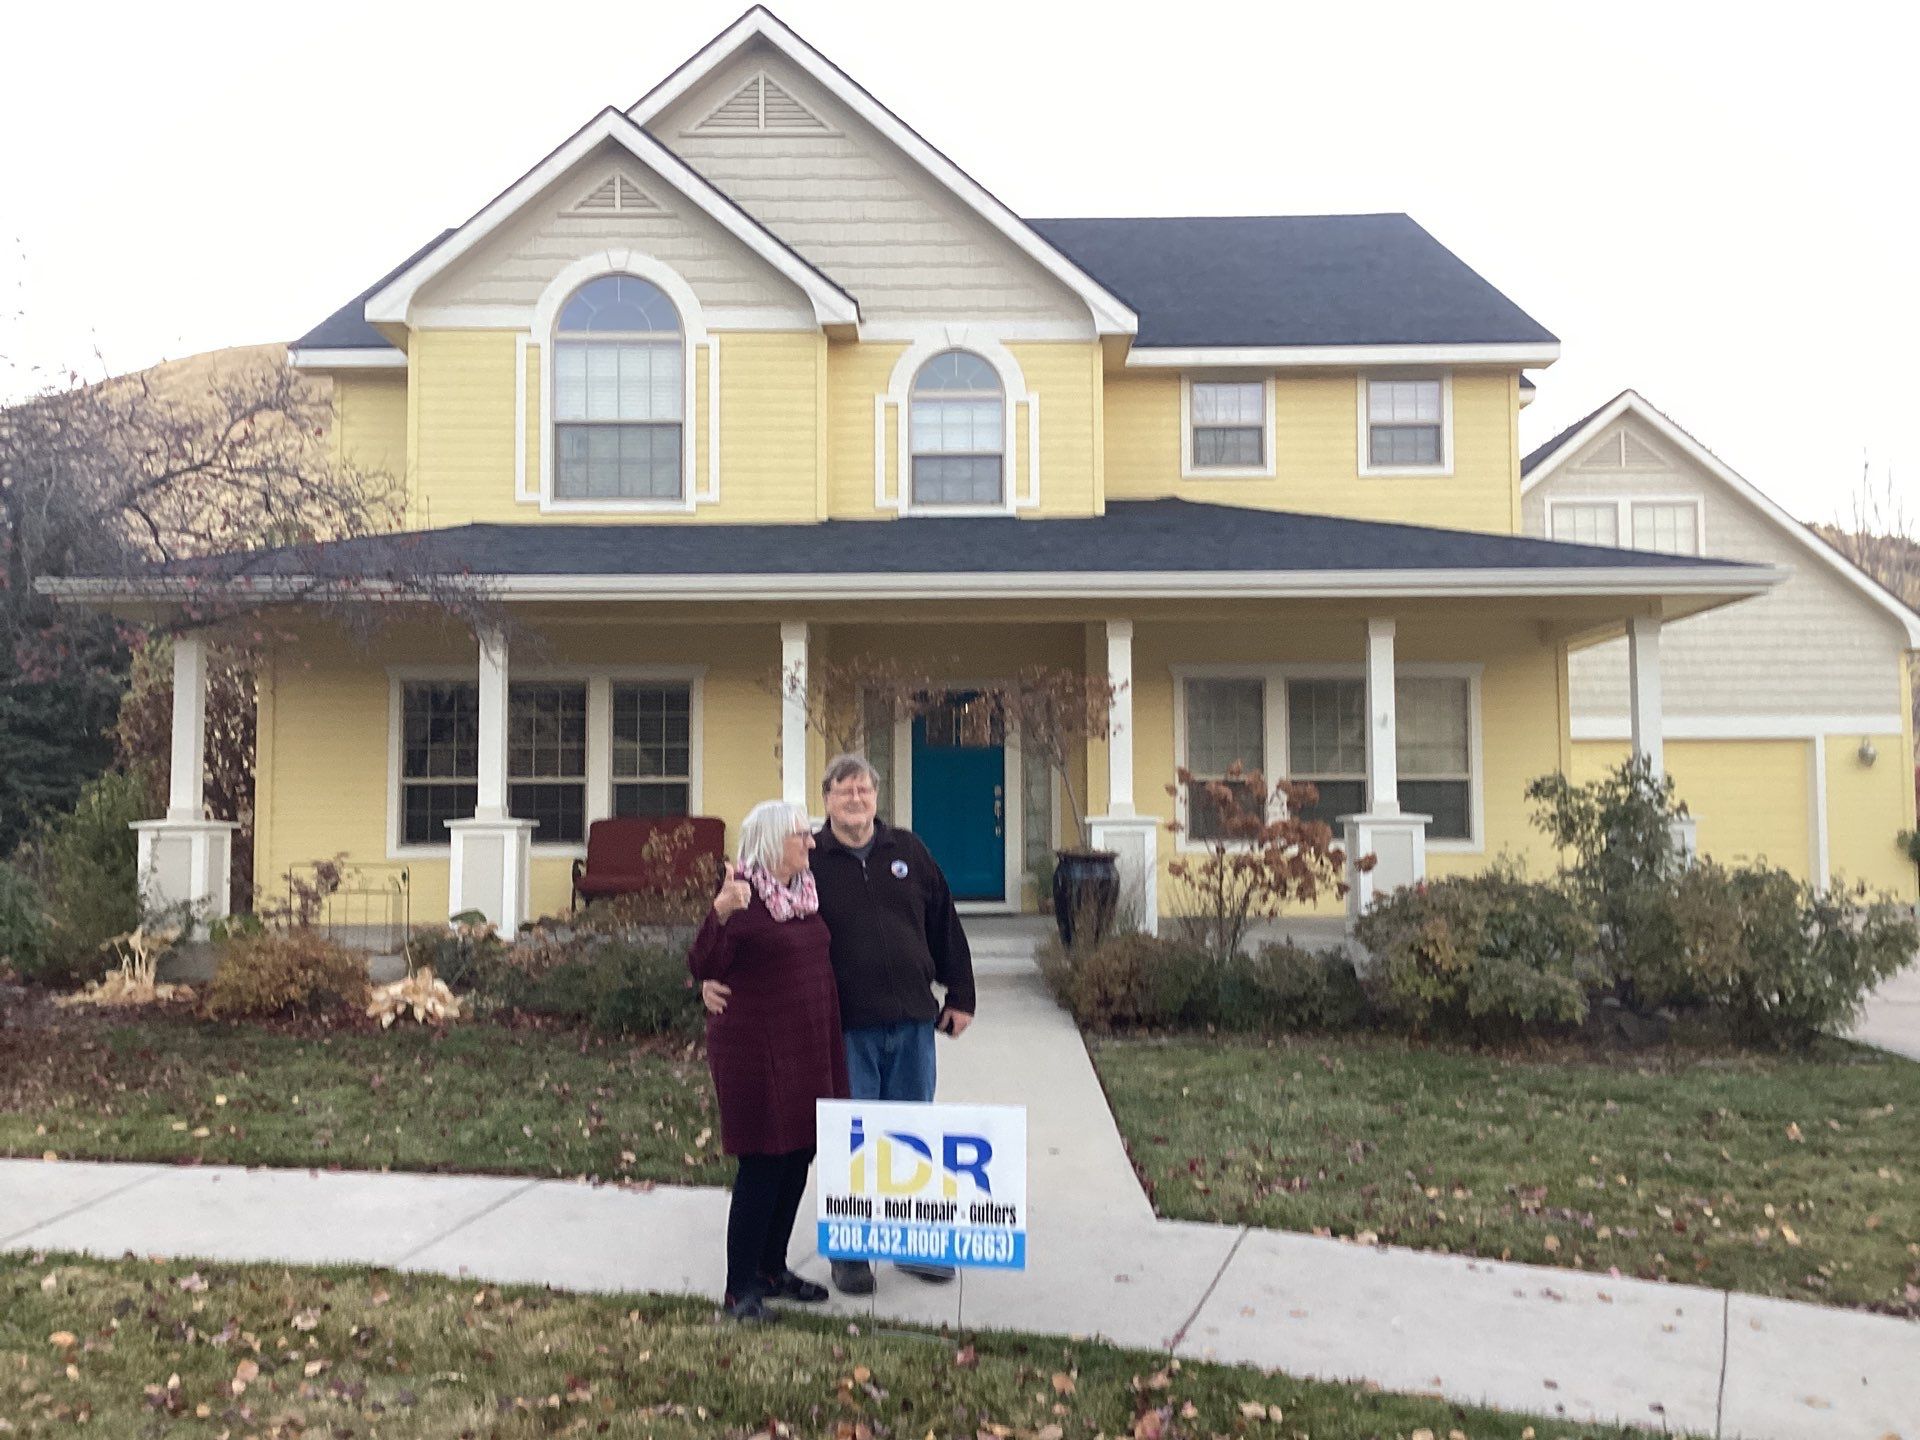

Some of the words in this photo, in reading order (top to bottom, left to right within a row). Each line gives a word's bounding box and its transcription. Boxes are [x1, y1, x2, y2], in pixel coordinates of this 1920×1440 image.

[826, 1195, 872, 1220] Roofing
[884, 1197, 912, 1219] Roof
[915, 1199, 957, 1224] Repair
[969, 1201, 1017, 1226] Gutters
[954, 1229, 1014, 1263] (7663)
